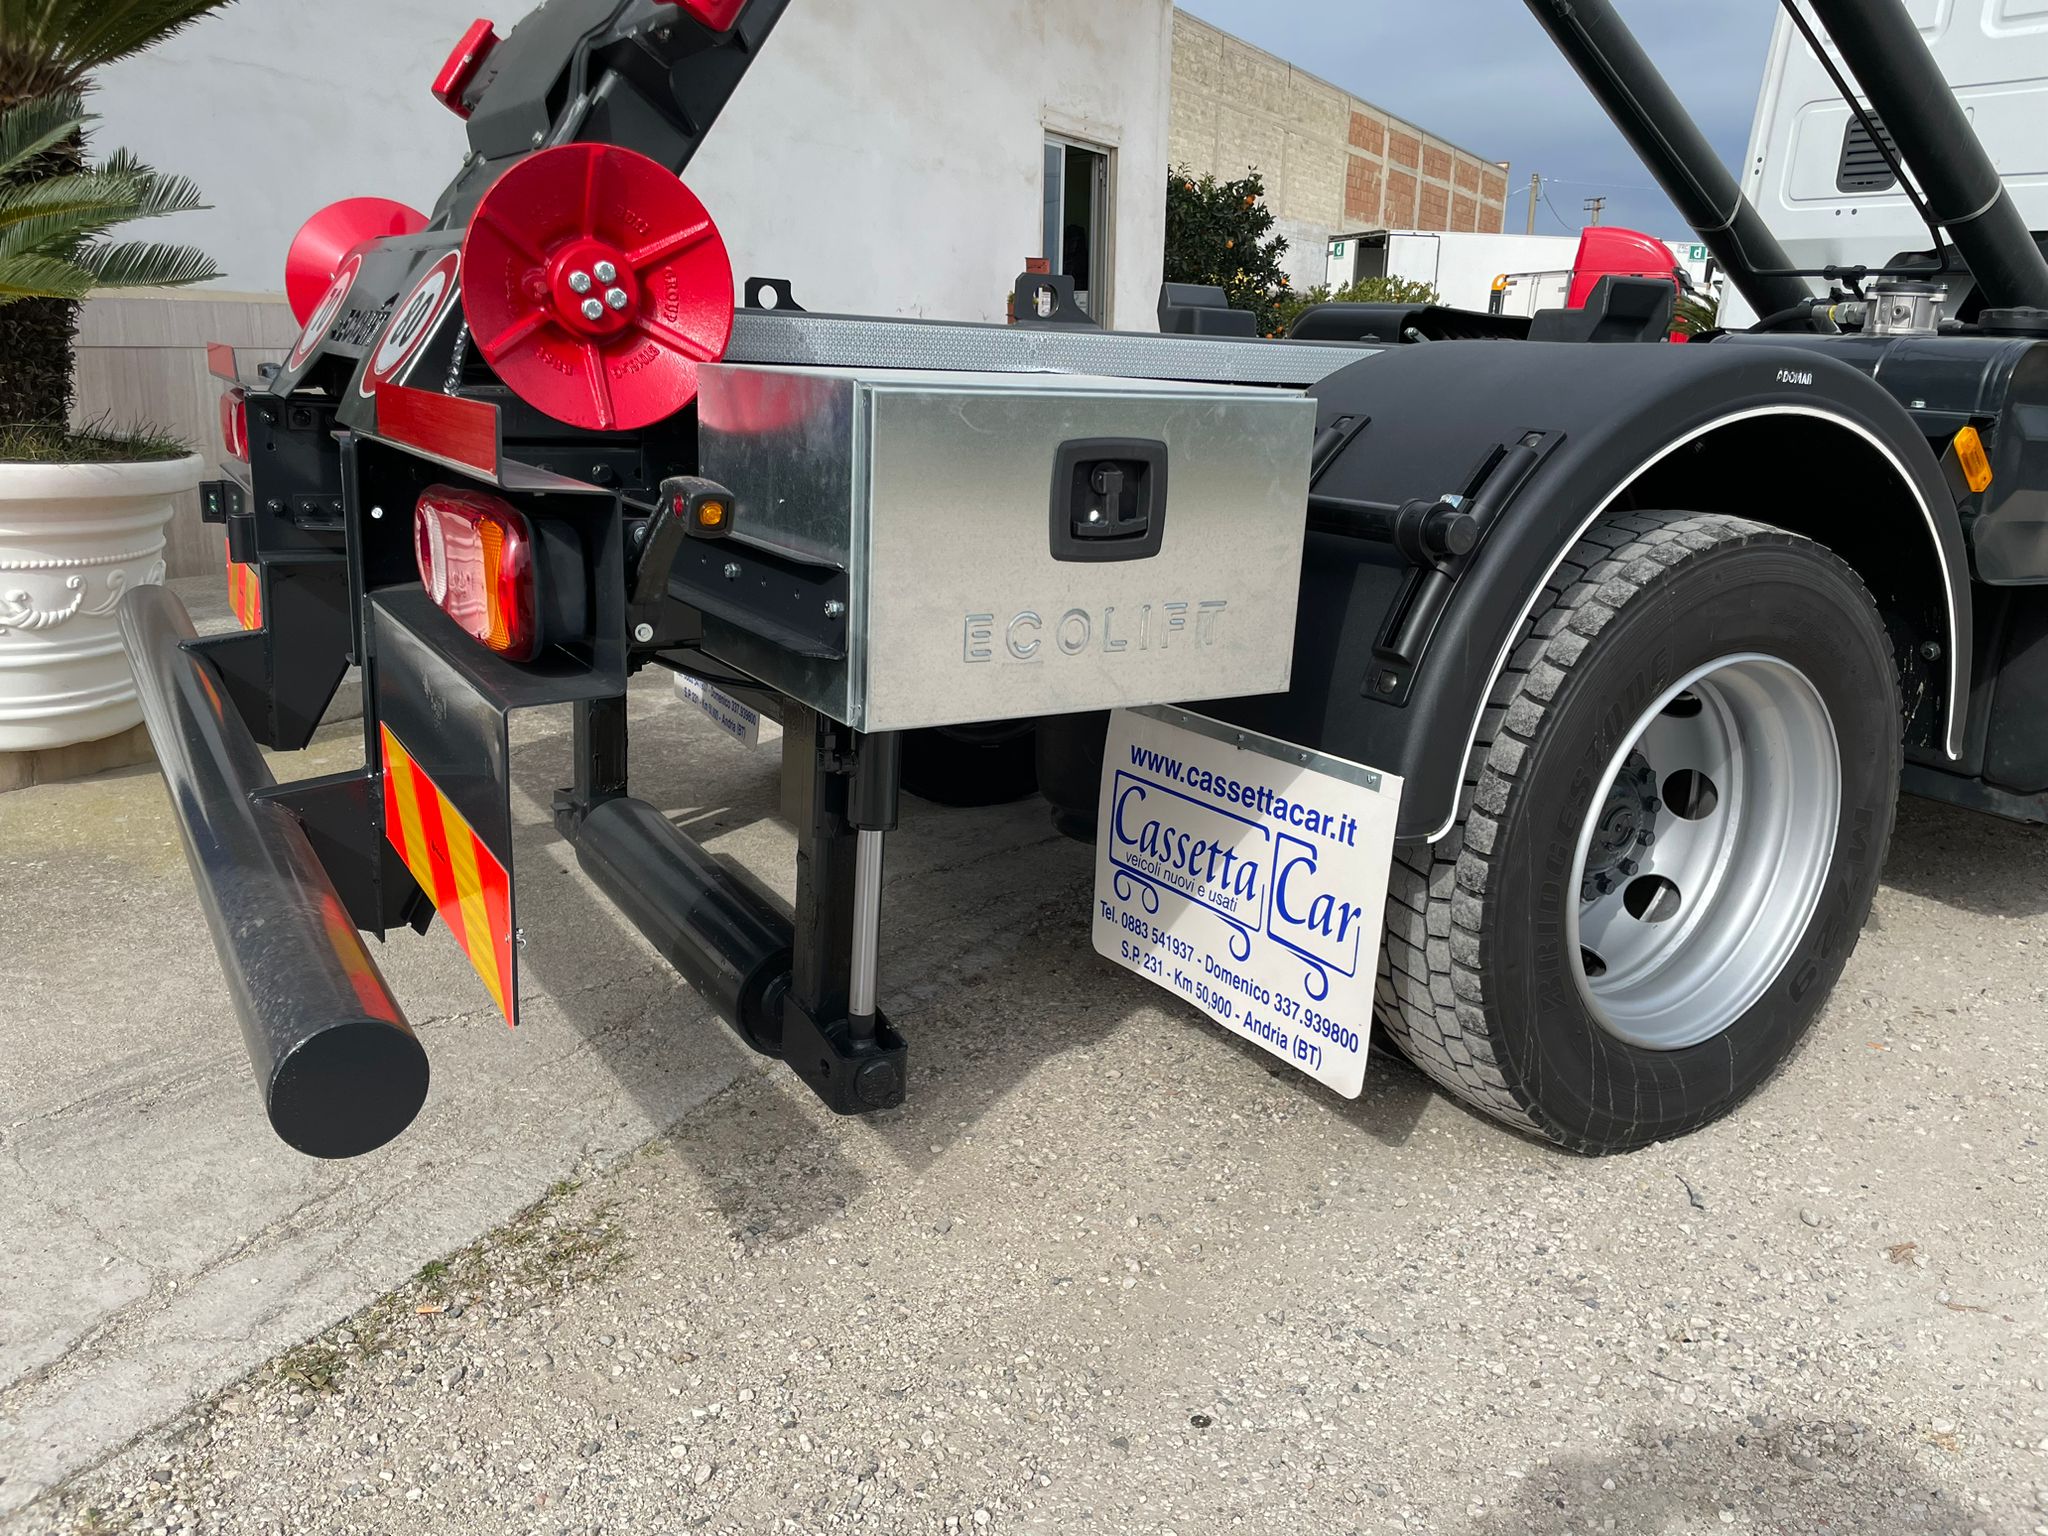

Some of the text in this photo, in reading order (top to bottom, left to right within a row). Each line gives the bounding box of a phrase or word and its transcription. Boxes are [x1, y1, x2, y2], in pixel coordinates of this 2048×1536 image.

[389, 290, 435, 348] 80
[963, 600, 1228, 663] ECOLIFT
[1114, 785, 1259, 902] Cassetta
[1130, 744, 1358, 848] www.cassettacar.it
[1125, 850, 1239, 913] veicoli nuovi e usati
[1275, 856, 1362, 943] Car
[1100, 900, 1118, 925] Tel.
[1121, 913, 1149, 940] 0883
[1151, 926, 1195, 963] 541937
[1204, 953, 1270, 1006] Domenico
[1274, 989, 1359, 1054] 337.939800
[1121, 940, 1141, 966] S.P.
[1143, 952, 1163, 978] 231
[1173, 968, 1193, 996] Km
[1195, 980, 1232, 1020] 50,900
[1243, 1011, 1288, 1051] Andria
[1293, 1033, 1323, 1072] (BT)
